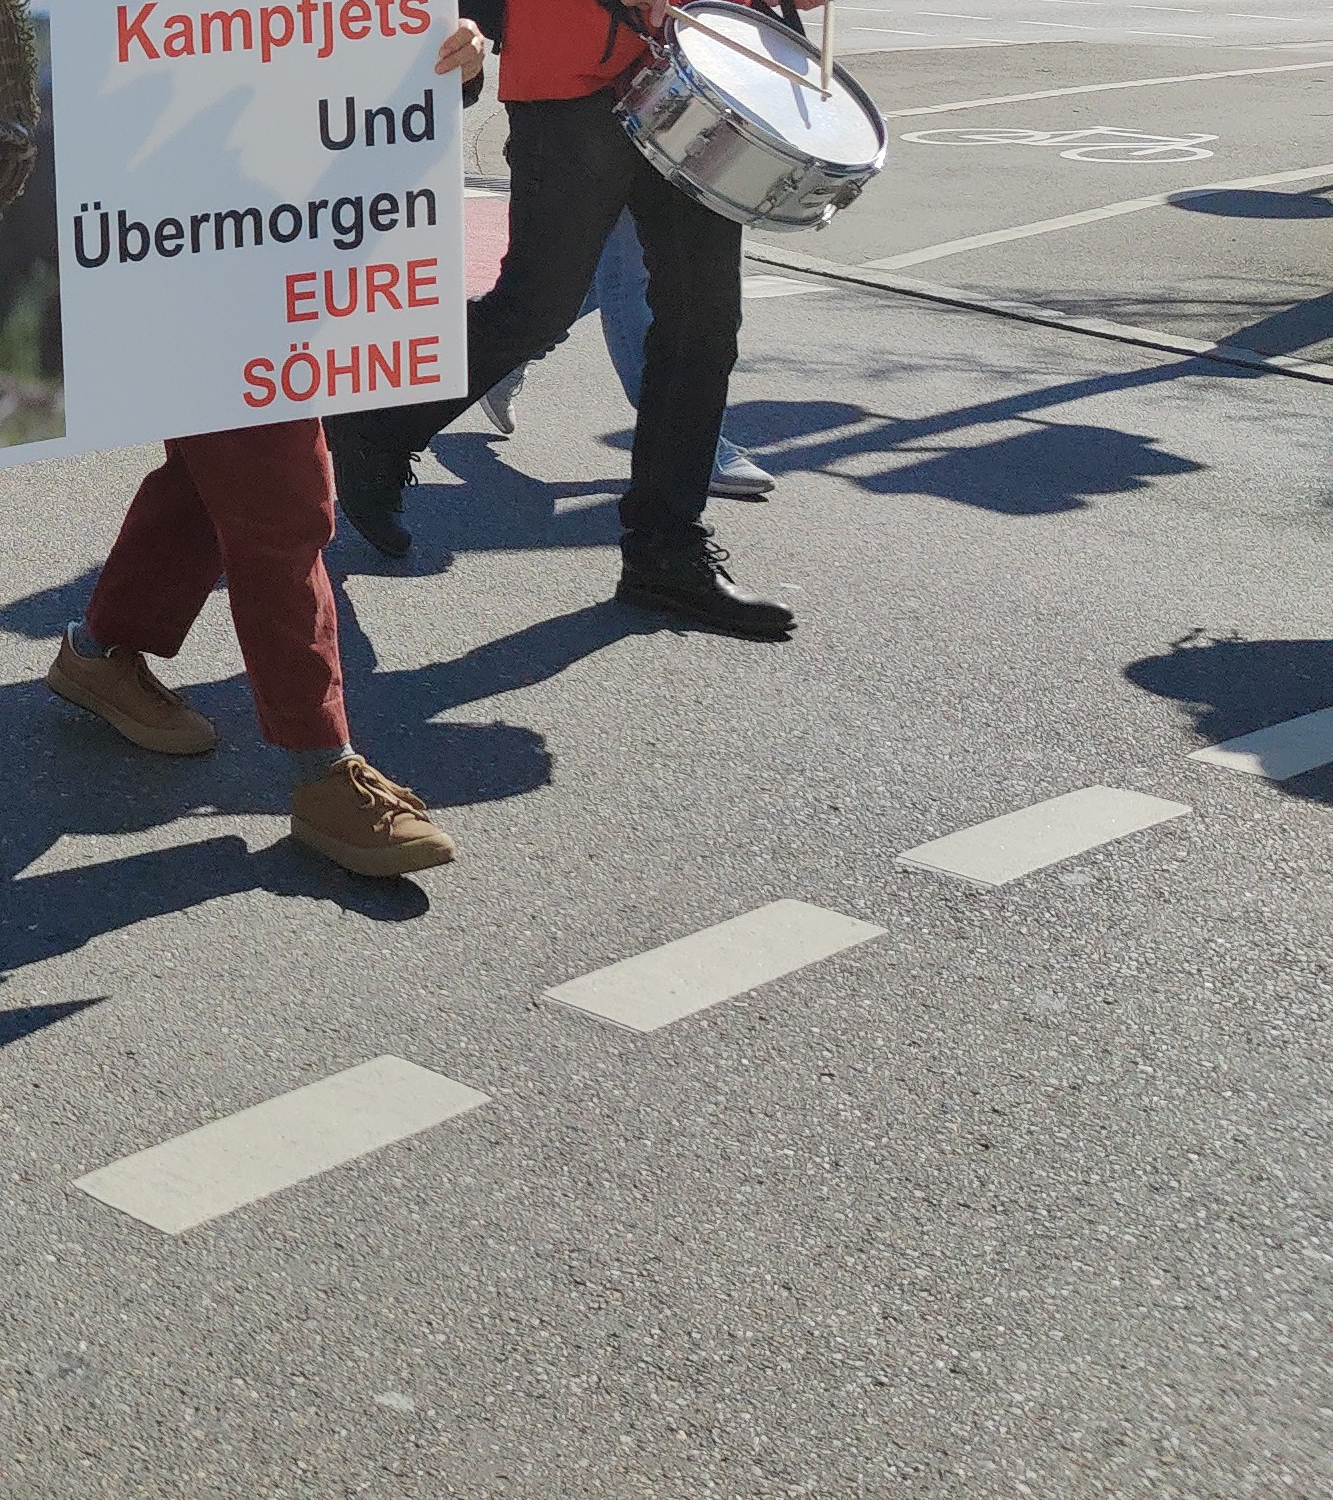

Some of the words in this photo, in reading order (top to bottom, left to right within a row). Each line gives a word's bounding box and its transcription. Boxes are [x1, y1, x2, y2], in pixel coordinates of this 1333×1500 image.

[318, 88, 436, 151] Und
[73, 187, 437, 269] Übermorgen
[285, 257, 440, 323] EURE
[242, 336, 441, 408] SÖHNE
